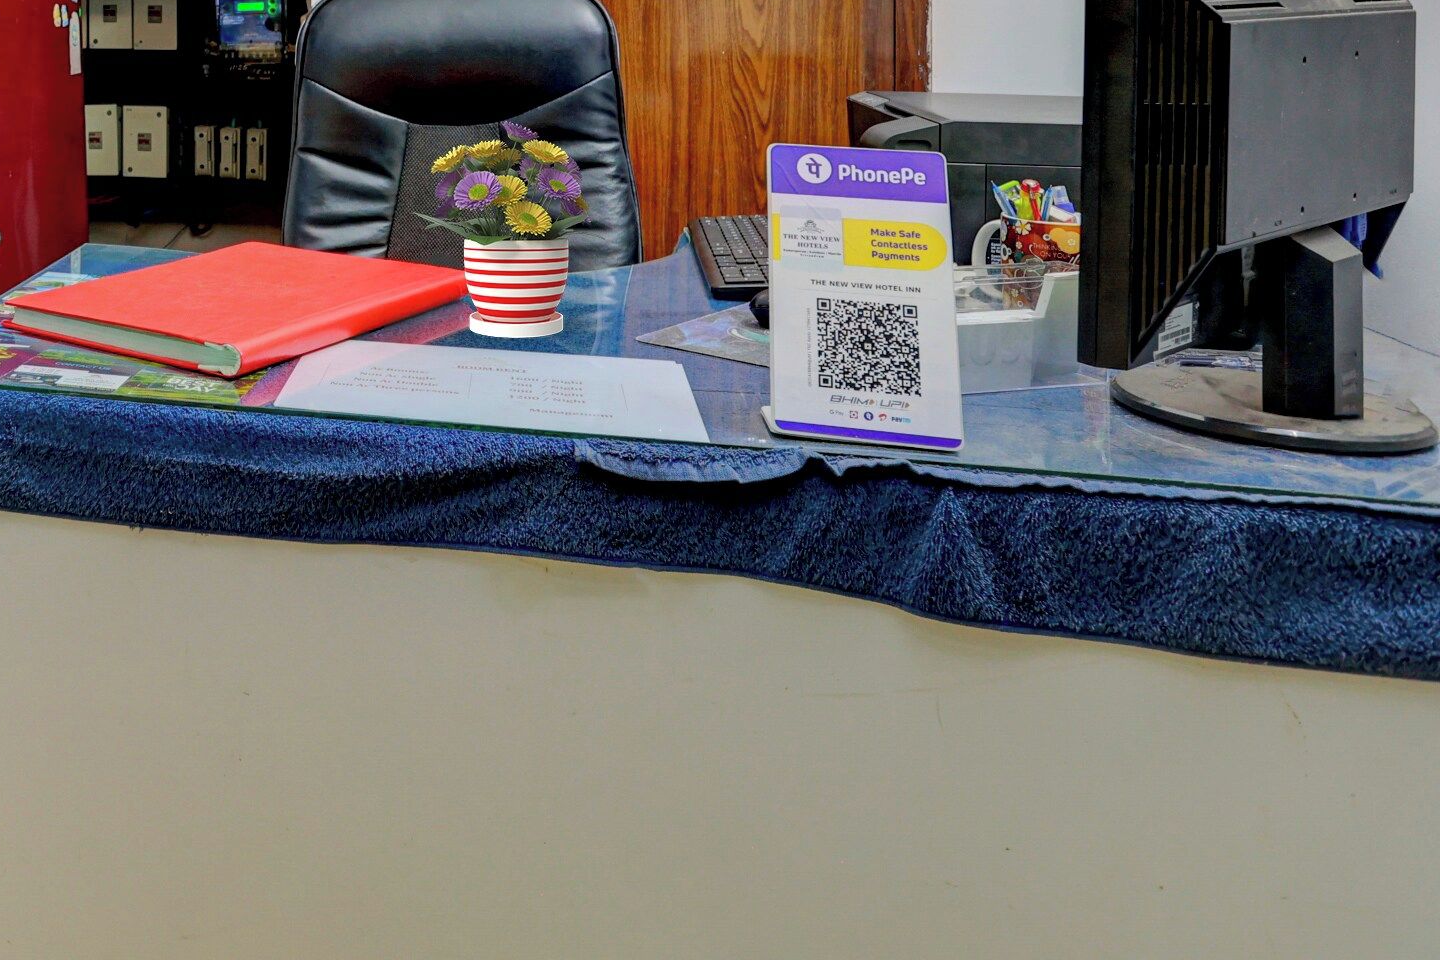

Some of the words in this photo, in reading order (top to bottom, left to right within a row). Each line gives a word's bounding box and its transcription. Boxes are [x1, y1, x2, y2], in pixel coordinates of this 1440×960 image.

[838, 164, 927, 186] PhonePe
[870, 228, 897, 238] Make
[898, 230, 921, 239] Safe
[871, 240, 928, 251] Contactless
[871, 250, 921, 262] Payments
[811, 279, 826, 287] THE
[829, 280, 849, 288] NEW
[852, 282, 873, 290] VIEW
[876, 284, 902, 292] HOTEL
[906, 286, 921, 294] INN
[830, 394, 869, 406] BHIM
[879, 399, 905, 409] UPI
